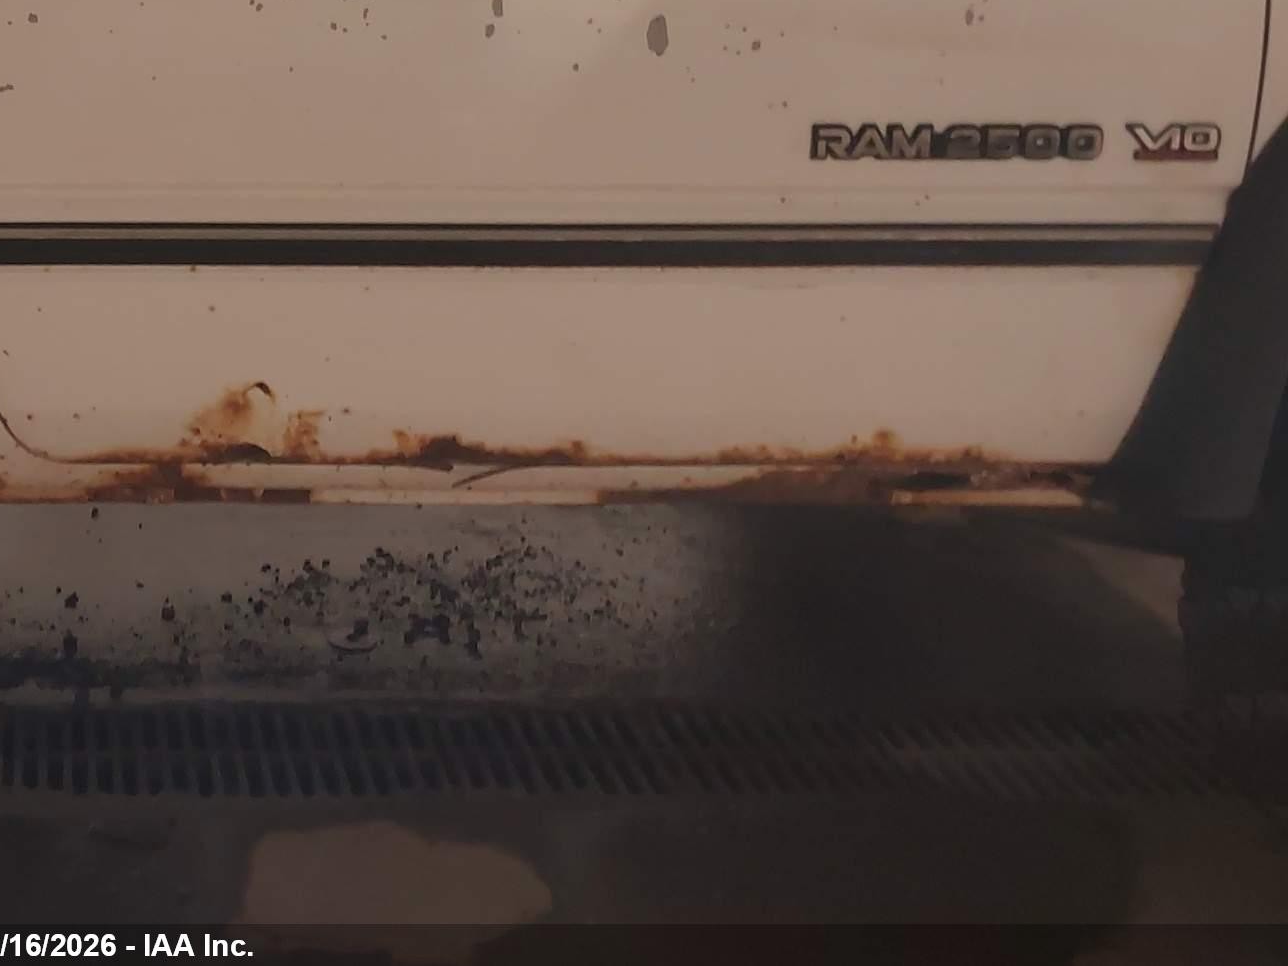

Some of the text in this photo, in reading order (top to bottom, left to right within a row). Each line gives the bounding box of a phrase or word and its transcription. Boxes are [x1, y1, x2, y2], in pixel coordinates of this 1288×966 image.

[810, 123, 1221, 160] RAM 2500 V10
